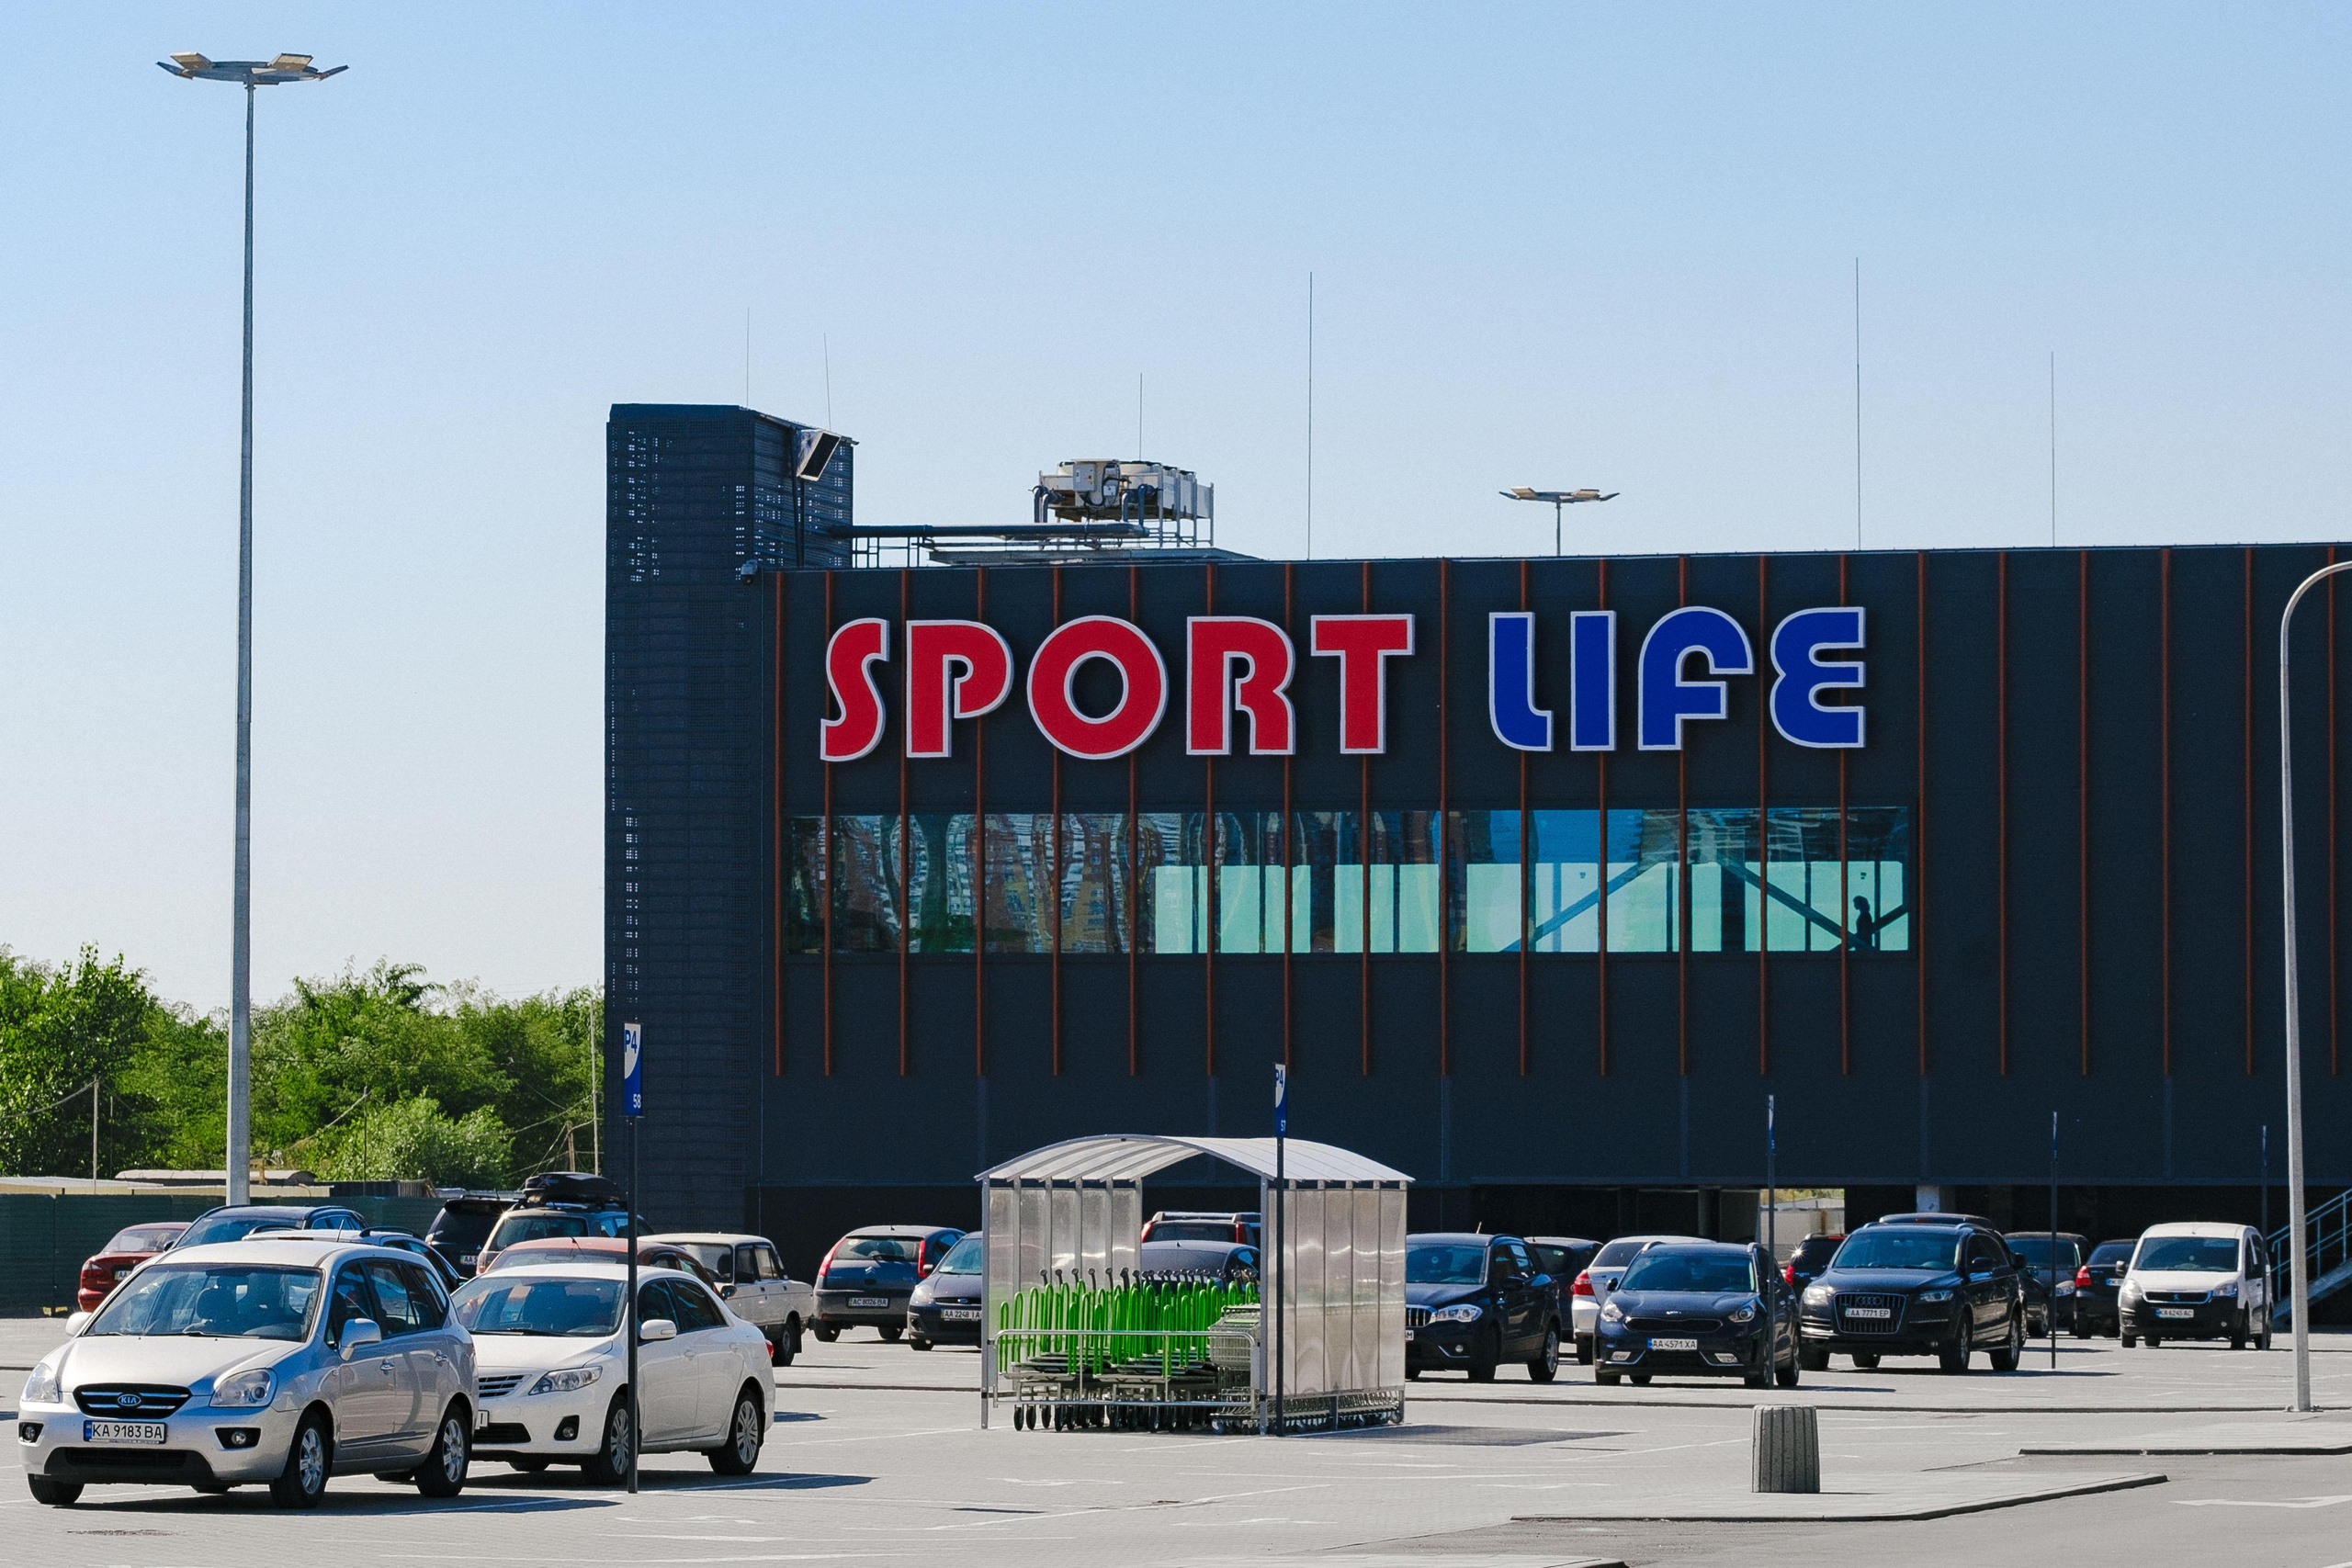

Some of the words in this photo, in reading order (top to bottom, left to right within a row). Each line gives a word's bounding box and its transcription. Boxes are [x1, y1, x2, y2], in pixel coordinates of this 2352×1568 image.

[820, 614, 1416, 762] SPORT
[1488, 605, 1866, 752] LIFE
[625, 1029, 638, 1054] P4
[633, 1093, 641, 1109] 58
[1861, 1309, 1878, 1317] 7771
[1653, 1339, 1663, 1348] AA
[1664, 1340, 1683, 1348] 4571
[92, 1424, 110, 1438] KA
[113, 1424, 141, 1438] 9183
[144, 1425, 163, 1439] BA
